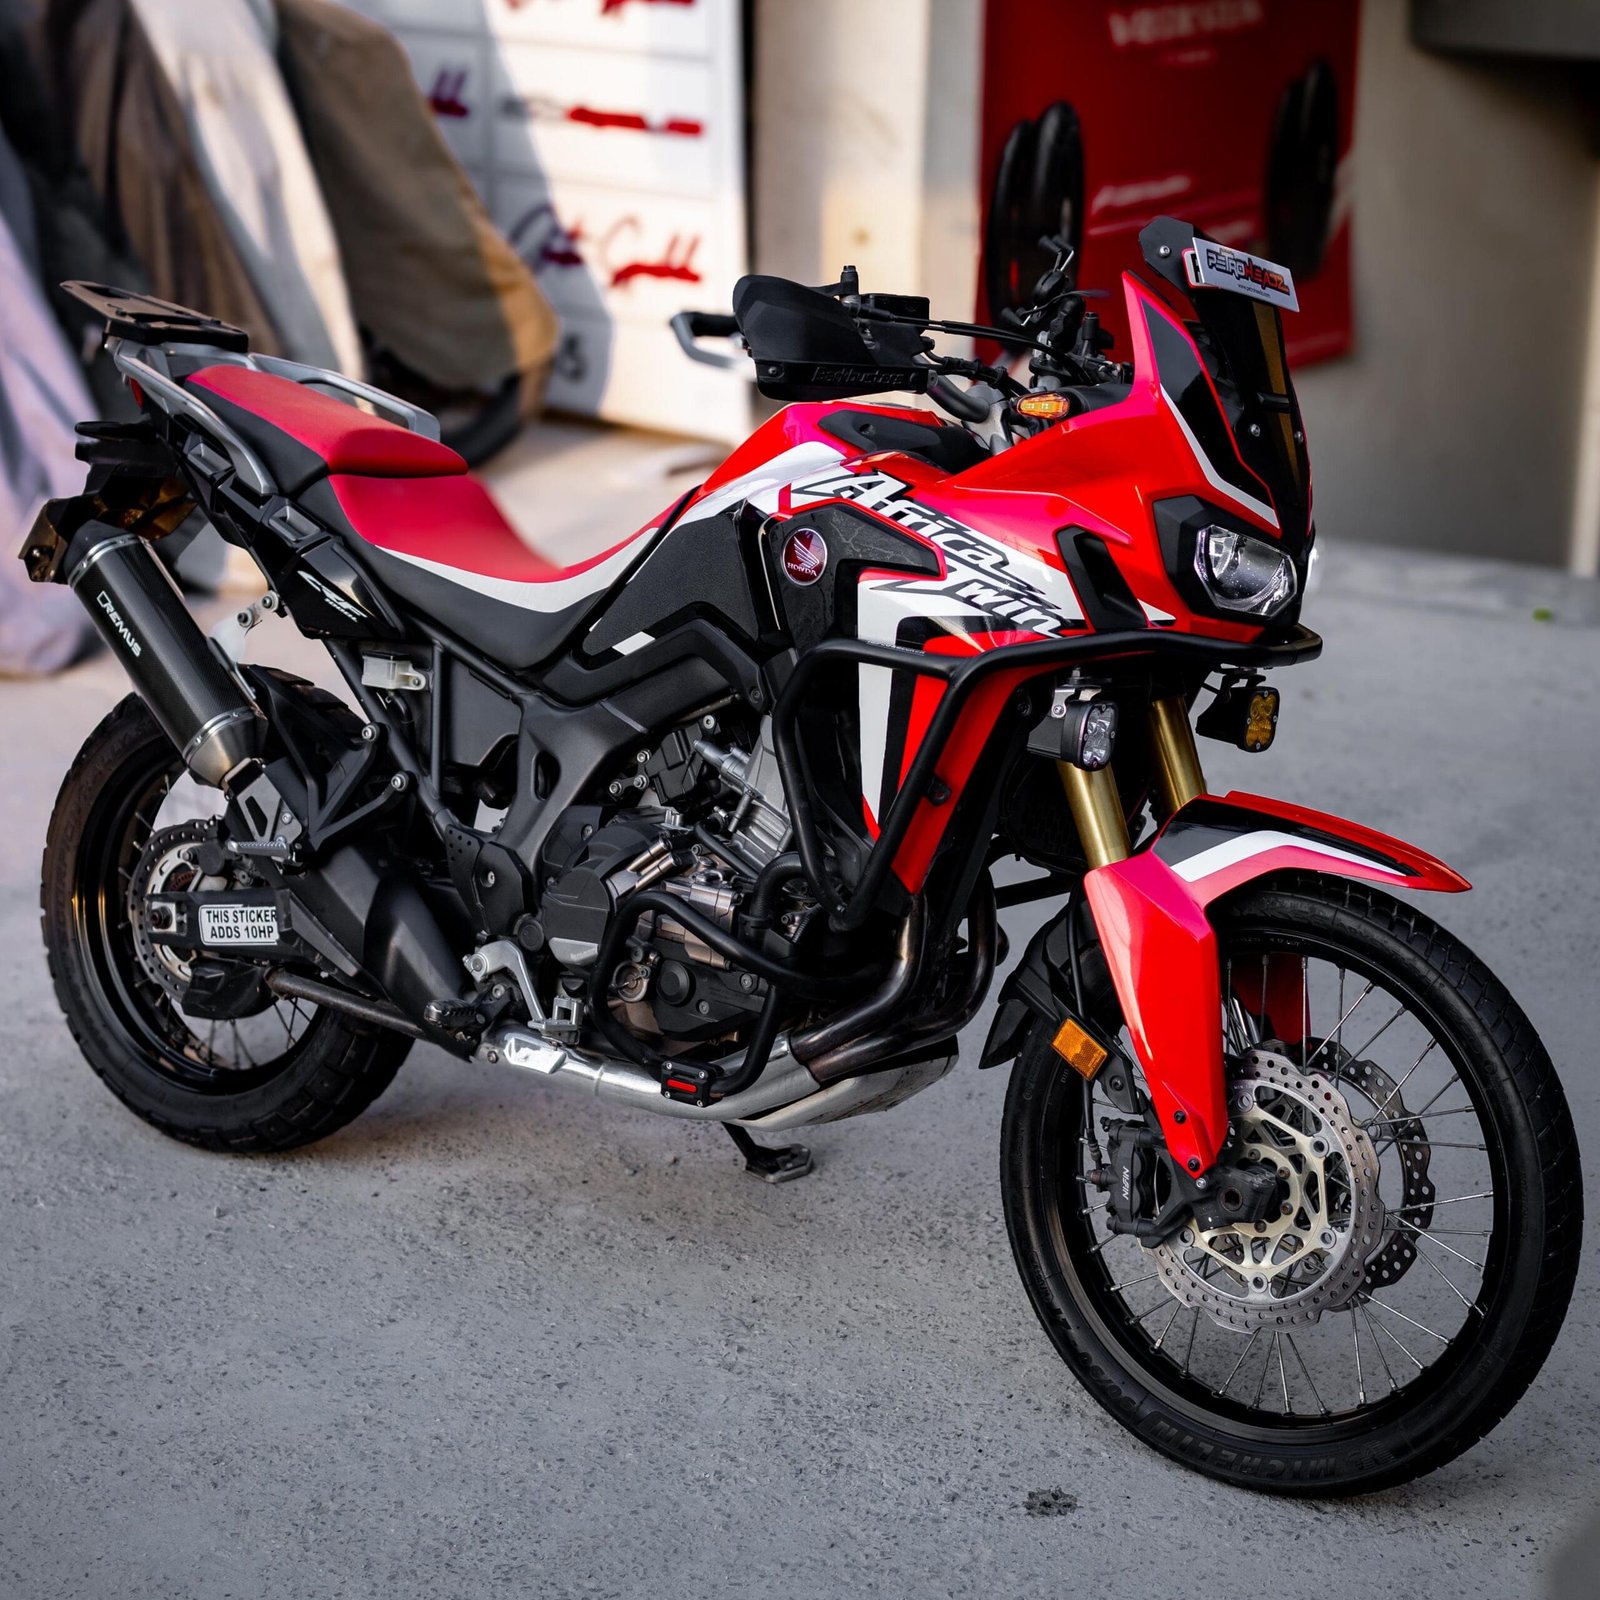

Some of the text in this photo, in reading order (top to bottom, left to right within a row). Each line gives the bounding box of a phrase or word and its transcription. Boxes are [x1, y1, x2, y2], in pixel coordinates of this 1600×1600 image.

[791, 468, 1018, 582] Africa
[786, 562, 818, 577] HONDA
[96, 590, 142, 657] REMUS
[206, 909, 278, 924] THIS STICKER
[210, 925, 274, 939] ADDS 10HP
[1150, 1419, 1338, 1478] MICHELIN
